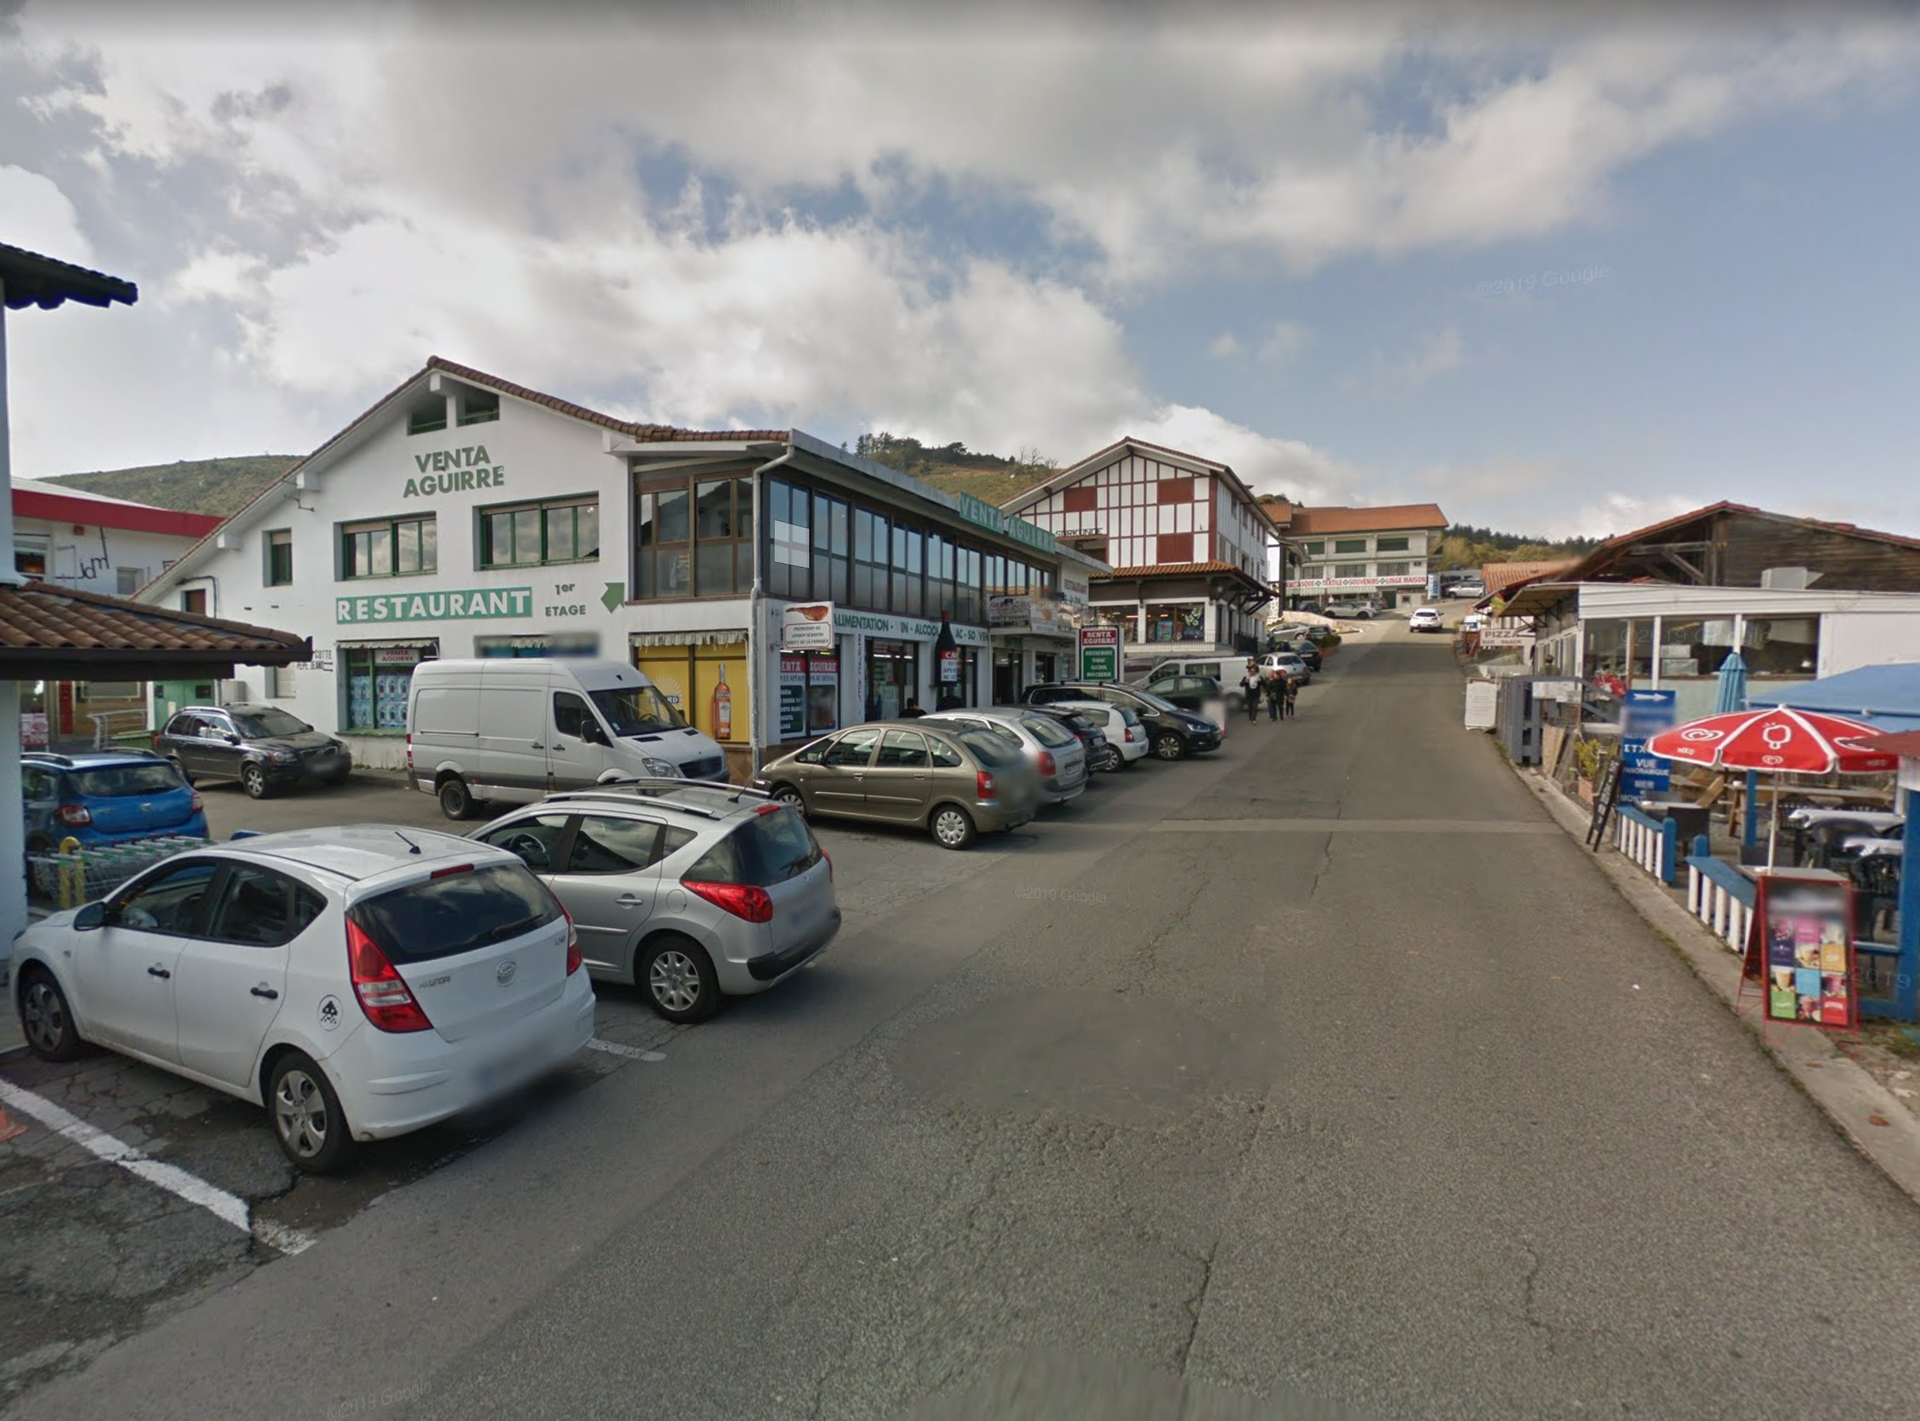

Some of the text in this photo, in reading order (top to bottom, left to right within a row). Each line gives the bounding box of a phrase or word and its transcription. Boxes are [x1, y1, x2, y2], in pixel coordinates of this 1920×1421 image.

[415, 445, 491, 474] VENTA
[403, 465, 505, 498] AGUIRRE
[960, 493, 1056, 554] VENTA AGUIRRE
[555, 582, 576, 595] 1er
[337, 590, 531, 622] RESTAURANT
[545, 605, 586, 617] ETAGE
[833, 611, 889, 632] ALIMENTATION
[1485, 630, 1519, 639] PIZZA
[1635, 758, 1657, 768] VUE
